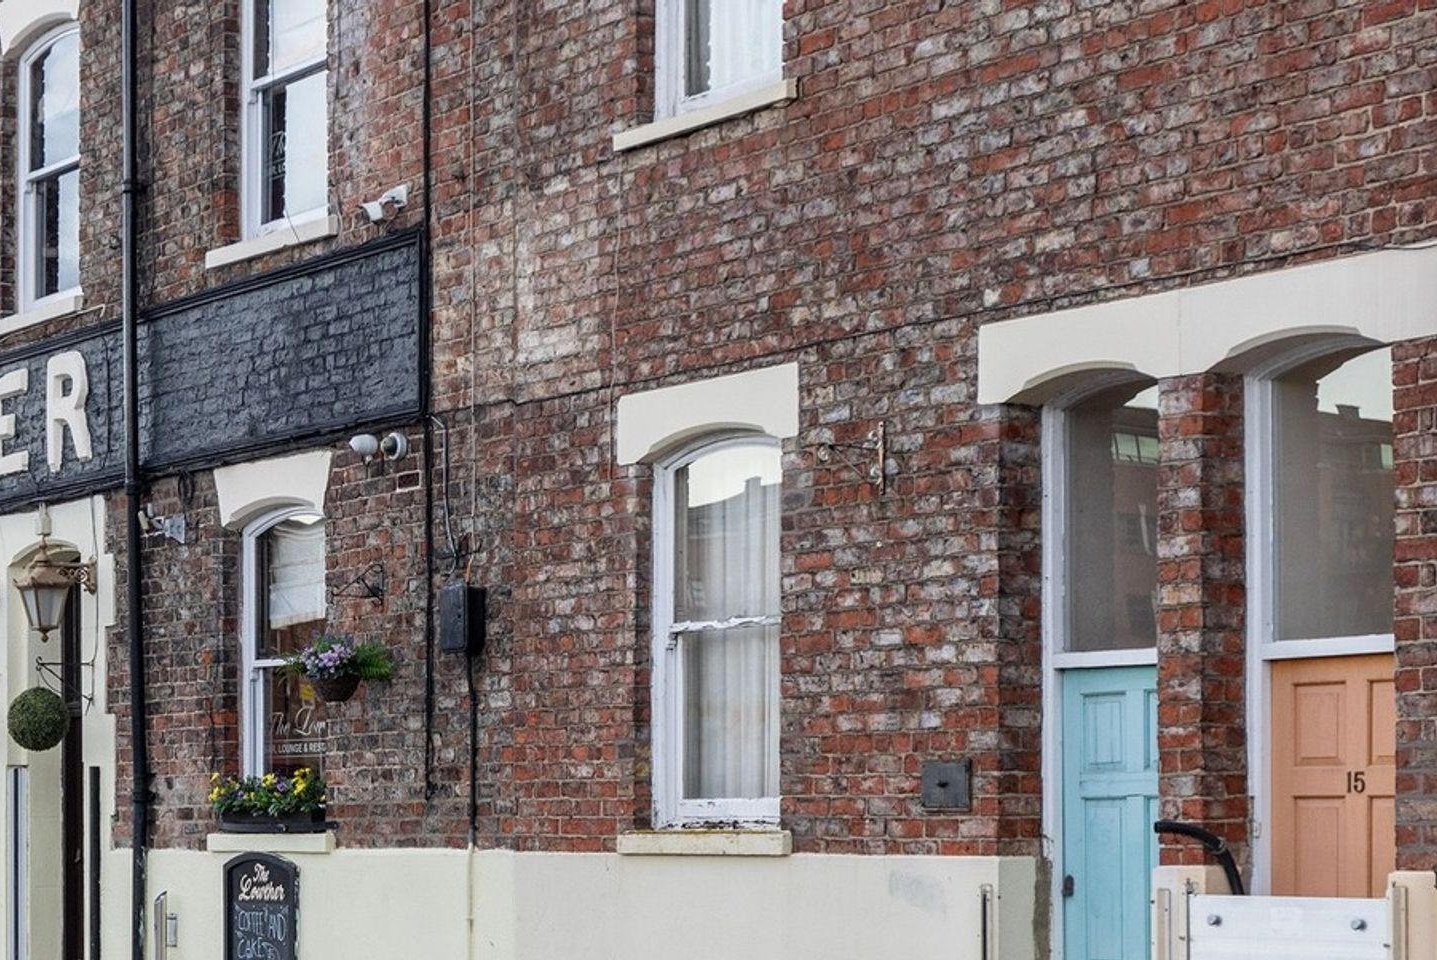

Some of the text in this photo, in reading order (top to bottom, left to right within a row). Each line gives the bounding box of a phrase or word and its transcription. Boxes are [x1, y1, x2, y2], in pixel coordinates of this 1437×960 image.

[1347, 771, 1366, 794] 15
[252, 863, 270, 882] The
[238, 873, 286, 901] Lowther
[238, 910, 286, 942] COFFEE AND
[237, 936, 266, 959] CAKE
